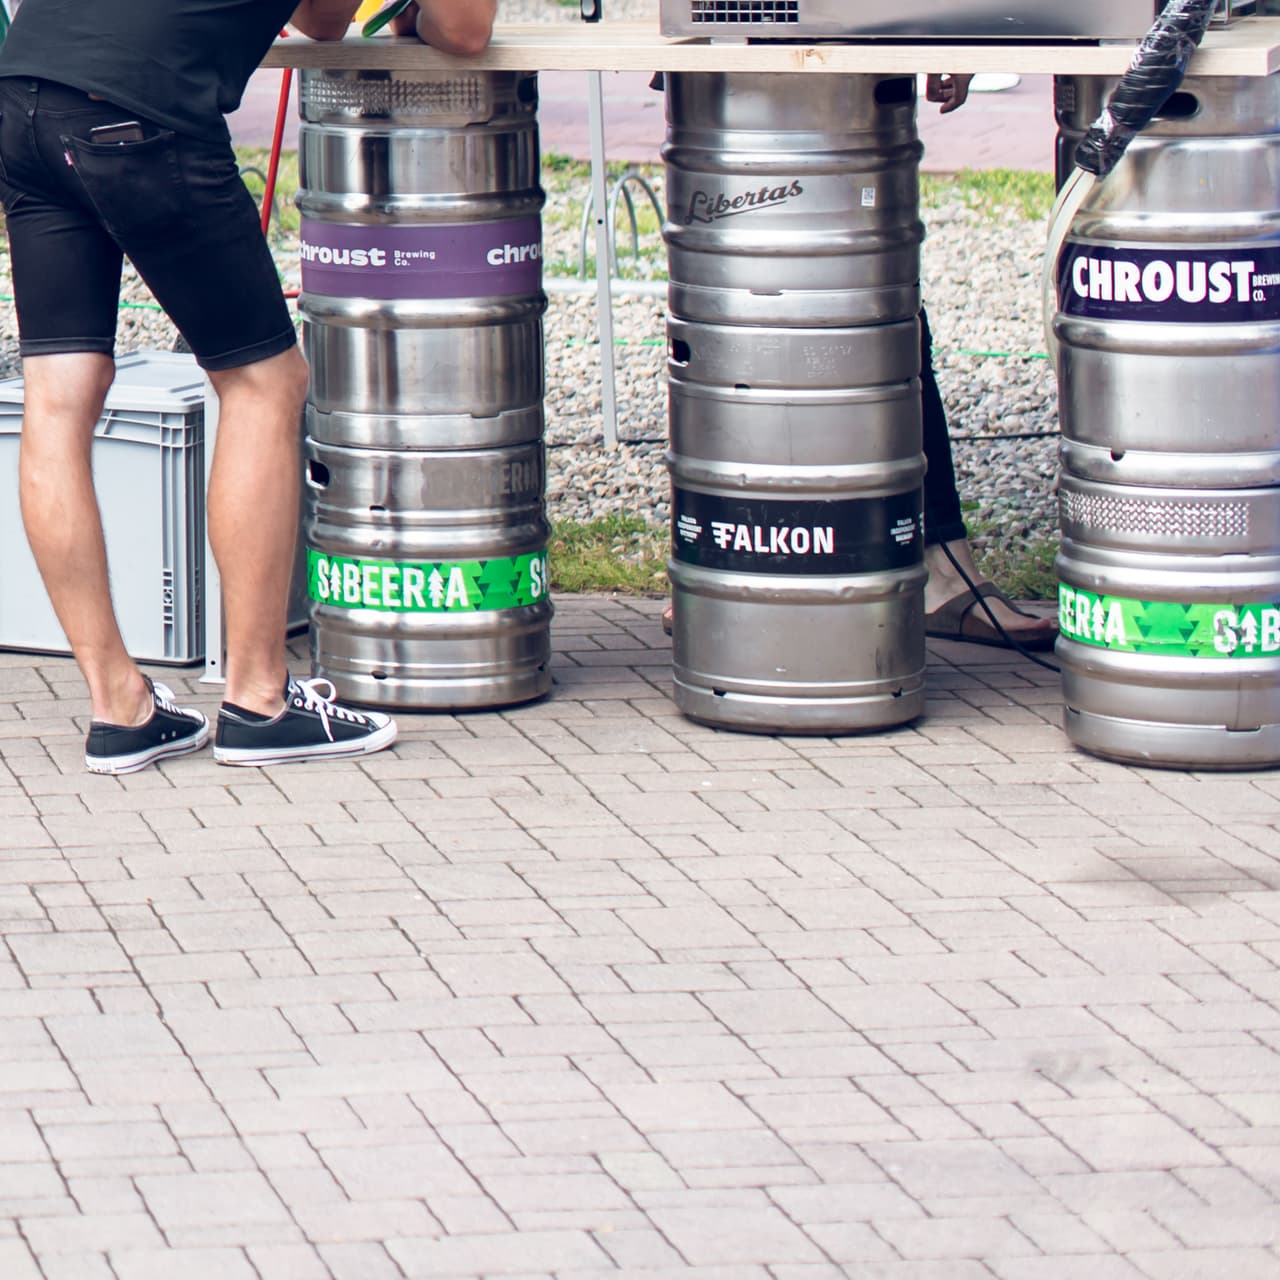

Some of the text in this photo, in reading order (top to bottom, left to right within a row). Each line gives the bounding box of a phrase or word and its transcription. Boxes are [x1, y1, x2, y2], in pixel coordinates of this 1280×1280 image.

[685, 179, 803, 224] Libertas
[394, 250, 436, 260] Brewing
[394, 258, 410, 266] Co.
[1072, 256, 1255, 303] CHROUST
[1252, 290, 1266, 302] CO.
[711, 521, 834, 554] FALKON
